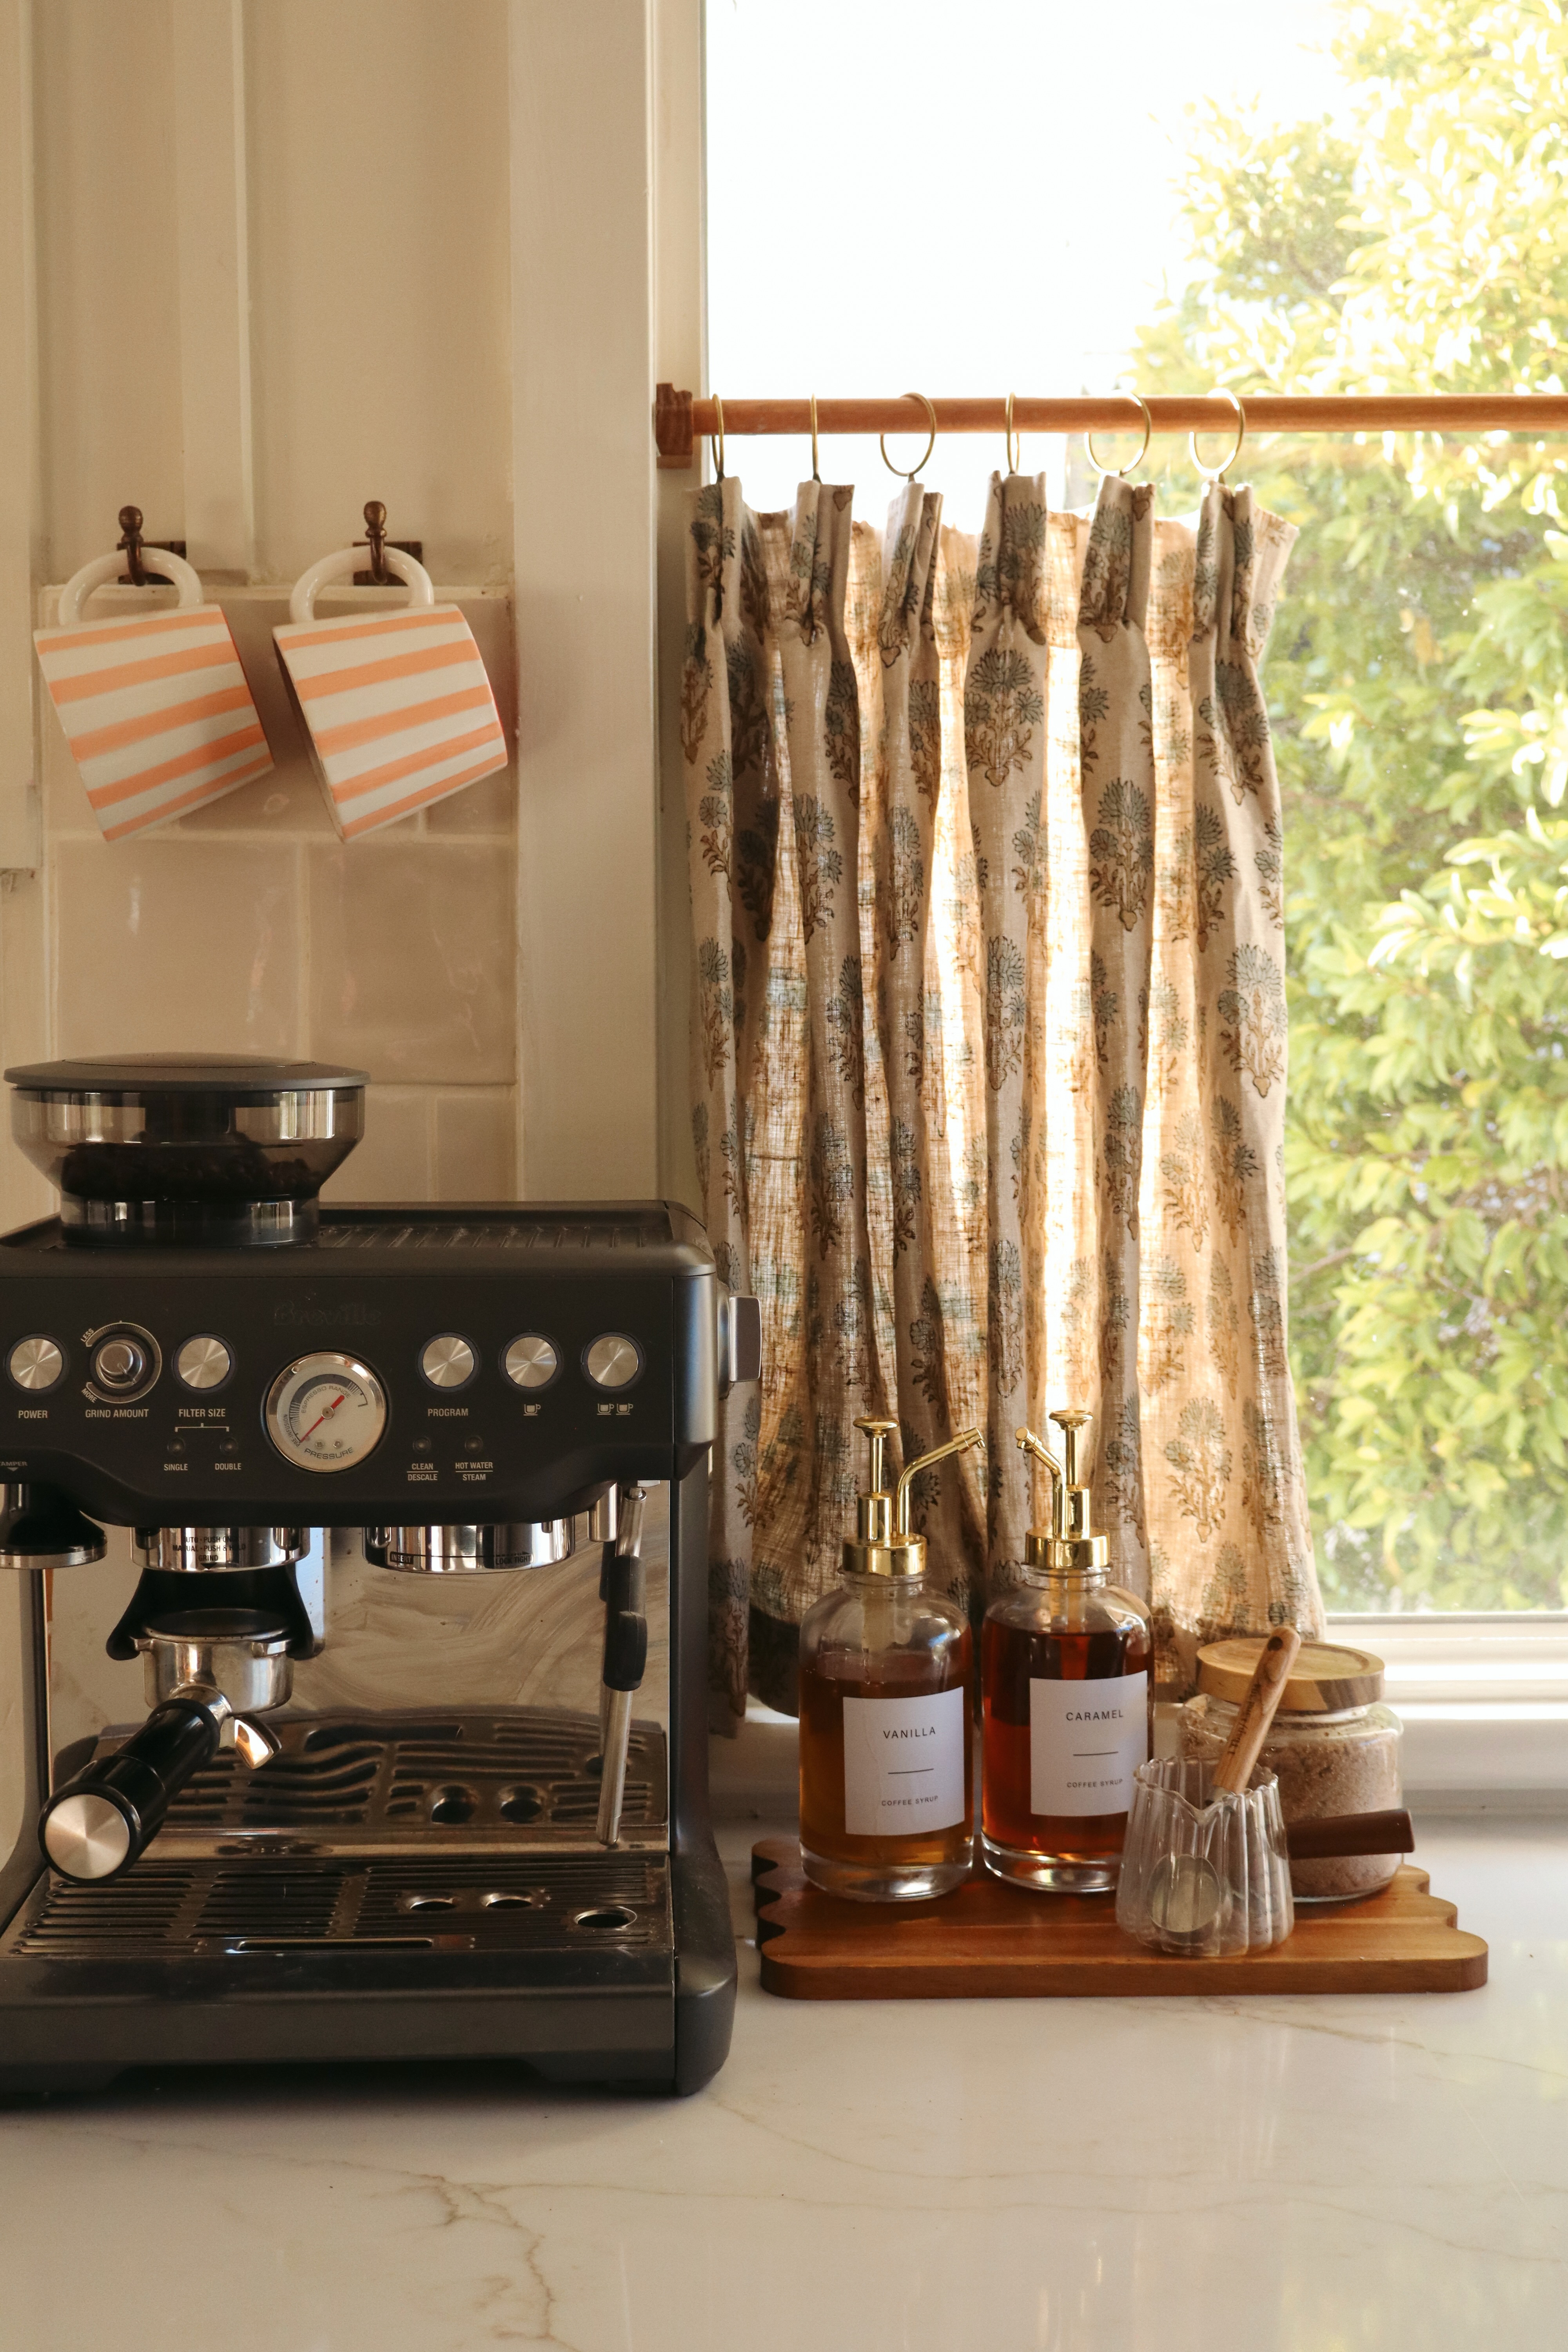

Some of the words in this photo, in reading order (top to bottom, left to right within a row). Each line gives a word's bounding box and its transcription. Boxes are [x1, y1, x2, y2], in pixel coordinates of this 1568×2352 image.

[80, 1328, 94, 1342] LESS
[82, 1388, 97, 1403] MORE
[301, 1386, 326, 1413] ESPRESSO
[329, 1386, 351, 1398] RANGE
[113, 1409, 149, 1417] AMOUNT
[179, 1409, 205, 1417] FILTER
[208, 1408, 226, 1417] SIZE
[428, 1408, 468, 1416] PROGRAM
[283, 1414, 300, 1447] PRE-INFUSION
[304, 1447, 354, 1459] PRESSURE
[391, 1554, 411, 1563] INSERT
[1066, 1710, 1123, 1720] CARAMEL
[883, 1726, 936, 1739] VANILLA
[1100, 1778, 1123, 1787] SYRUP
[915, 1795, 938, 1804] SYRUP
